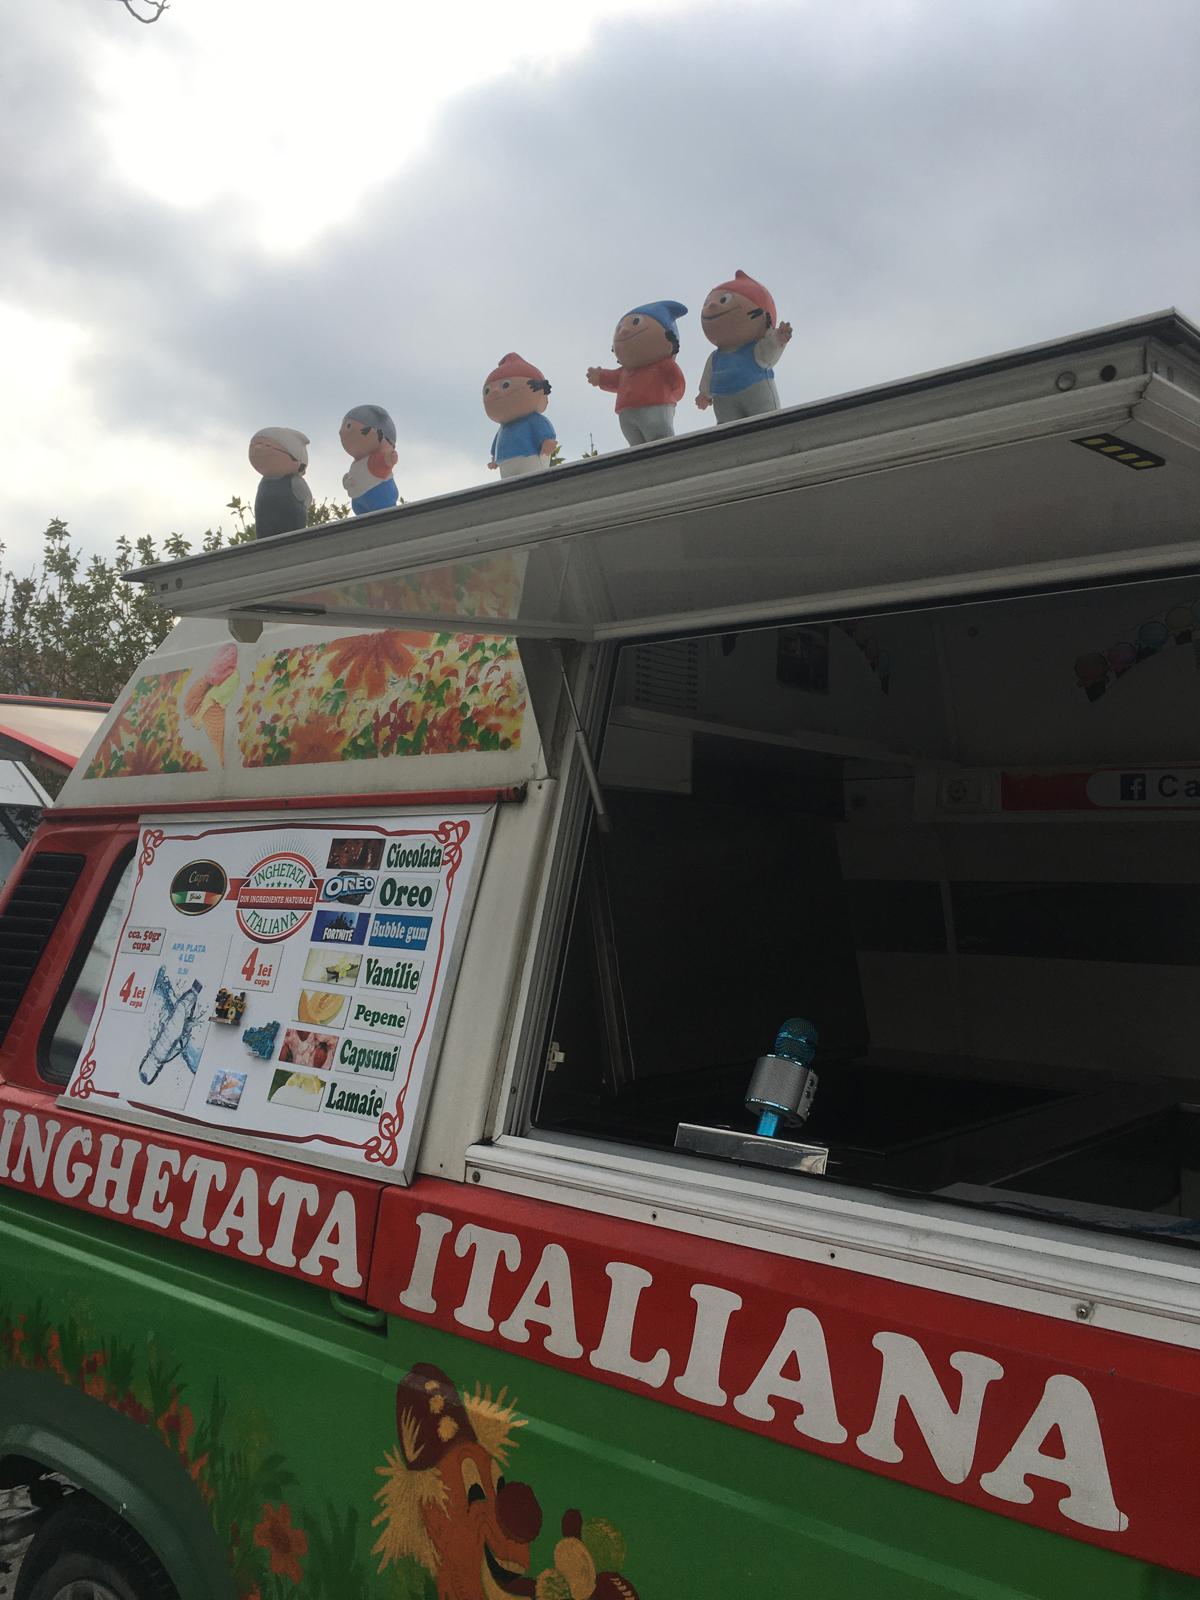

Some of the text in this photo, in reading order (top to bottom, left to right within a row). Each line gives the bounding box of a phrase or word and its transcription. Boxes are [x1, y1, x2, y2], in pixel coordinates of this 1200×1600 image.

[386, 842, 441, 868] Ciocolata
[253, 863, 307, 888] INGHETATA
[326, 876, 375, 896] OREO
[250, 895, 285, 904] INGREDIENTE
[285, 896, 313, 905] NATURALE
[379, 878, 433, 907] Oreo
[246, 910, 299, 934] ITALIANA
[322, 927, 354, 942] FORTNITE
[371, 920, 428, 943] Bubble gum
[132, 942, 151, 952] cupa
[241, 947, 273, 982] 4 lei
[365, 957, 420, 990] Vanilie
[119, 971, 146, 1002] 4 lei
[254, 978, 270, 987] cupa
[129, 1000, 143, 1008] cupa
[354, 1004, 406, 1029] Pepene
[339, 1039, 399, 1073] Capsuni
[325, 1082, 383, 1118] Lamaie
[0, 1108, 1129, 1532] INGHETATA ITALIANA
